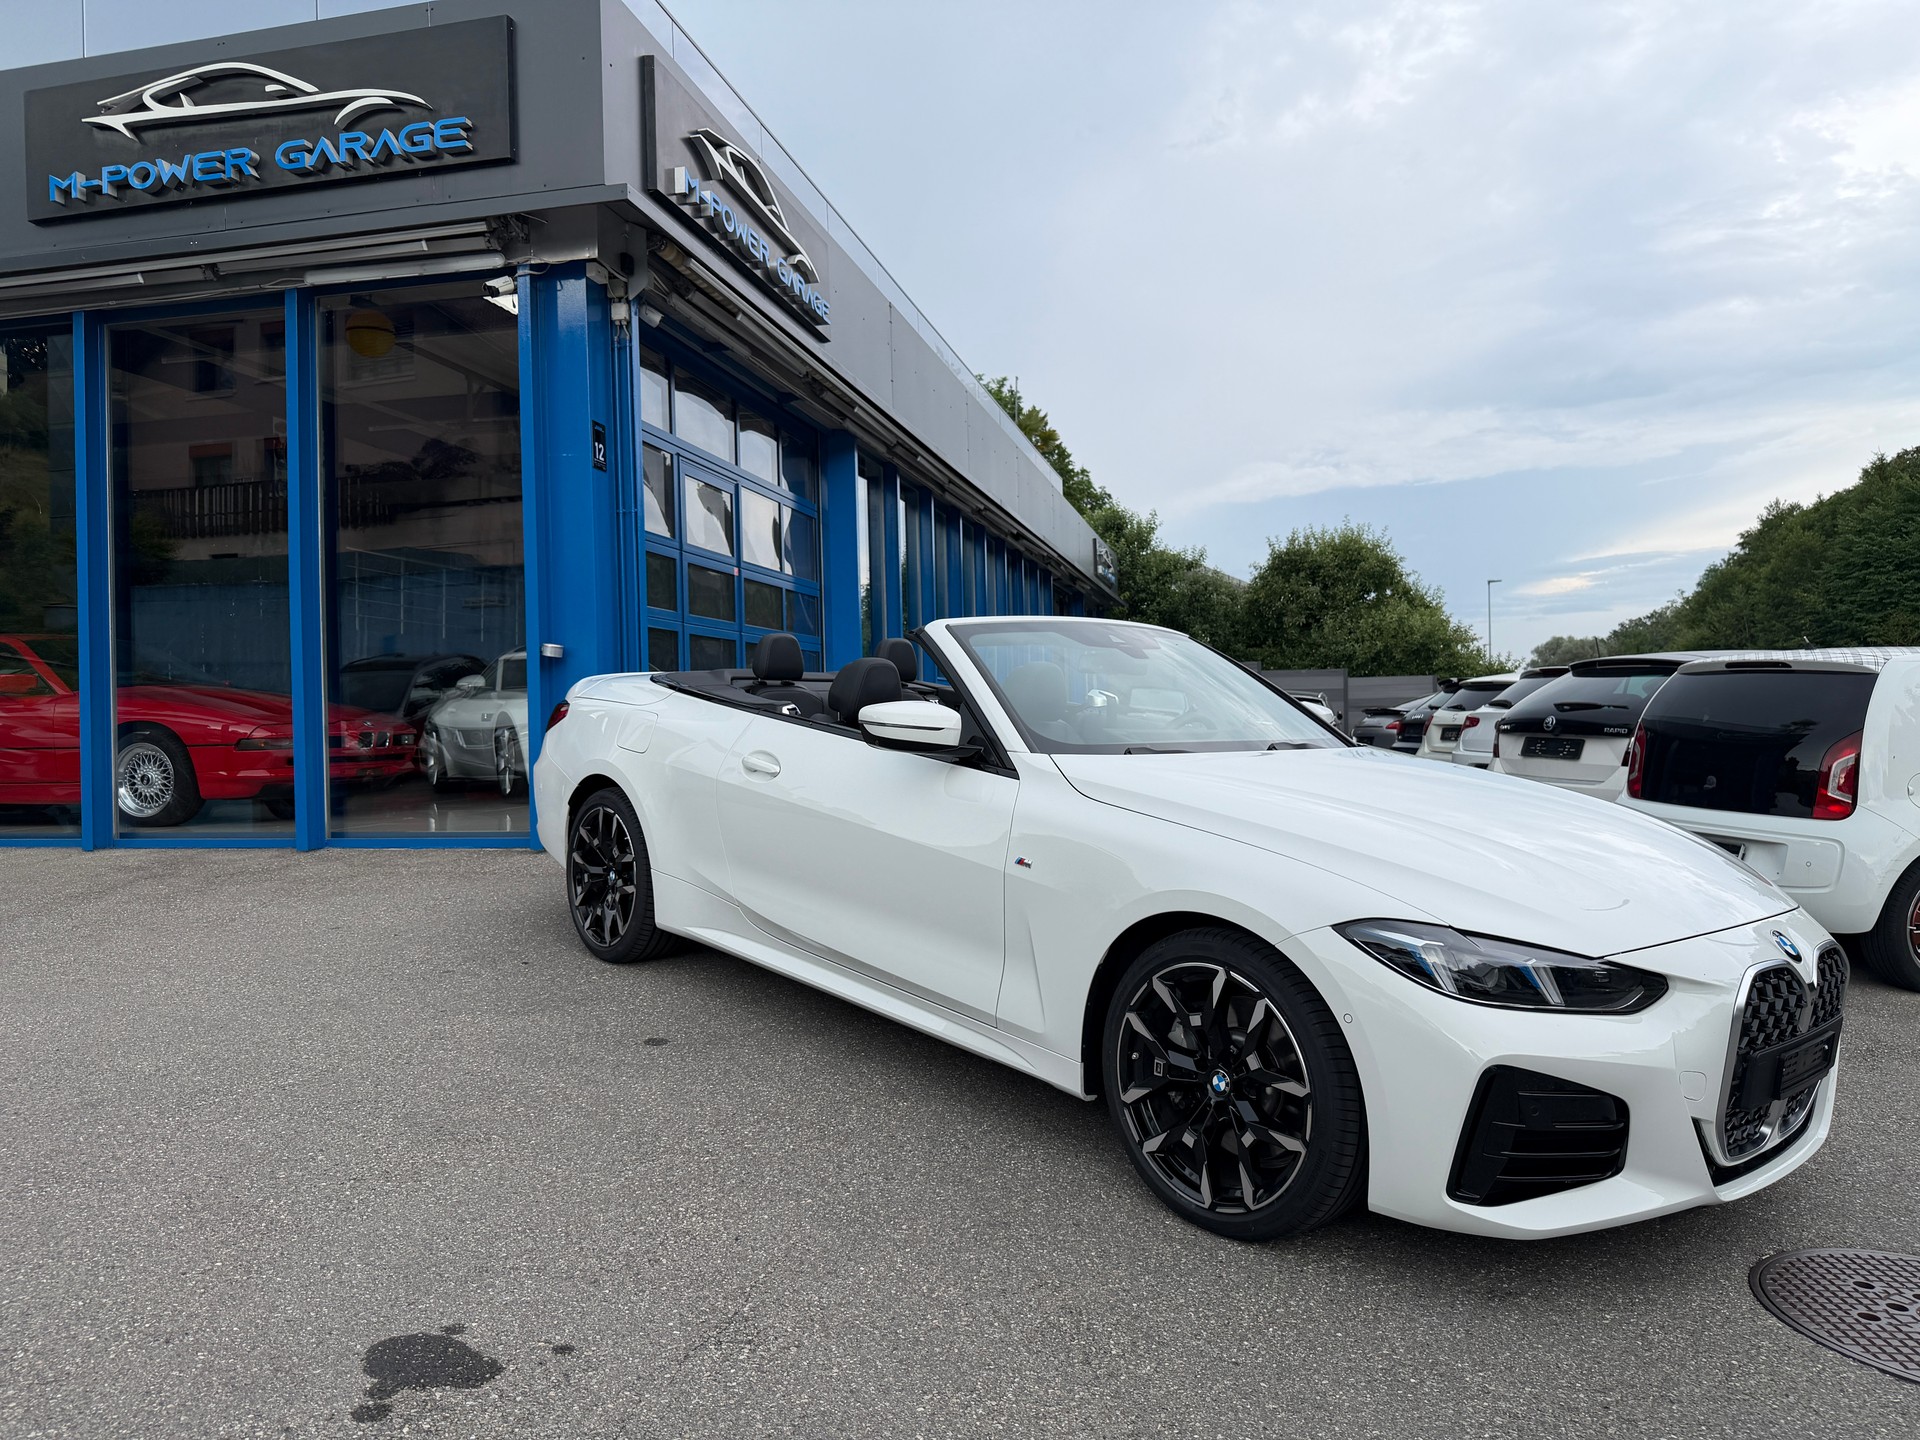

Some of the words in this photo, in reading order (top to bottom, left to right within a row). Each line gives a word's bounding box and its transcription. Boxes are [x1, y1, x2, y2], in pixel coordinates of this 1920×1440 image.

[48, 147, 256, 203] M-POWER
[274, 116, 469, 171] GARAGE
[684, 167, 770, 268] M-POWER
[776, 257, 831, 325] GARAGE
[594, 441, 605, 461] 12
[1603, 727, 1628, 735] RAPID
